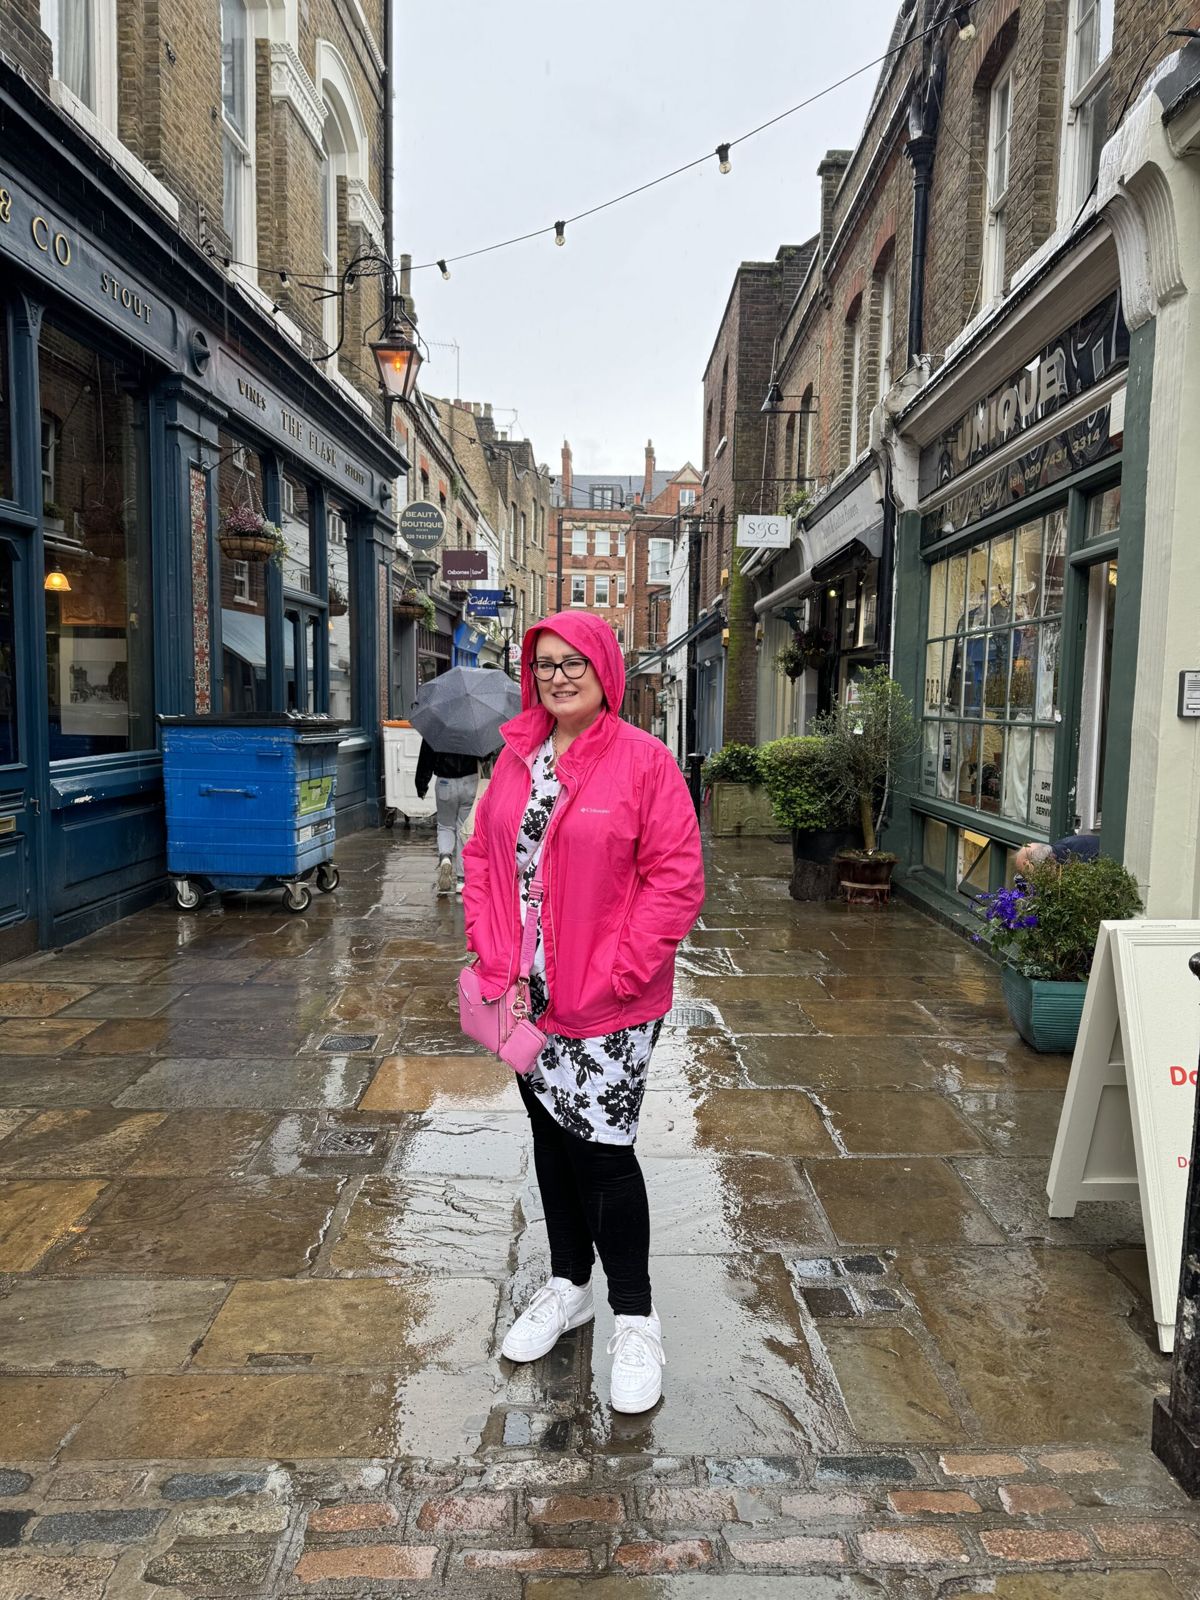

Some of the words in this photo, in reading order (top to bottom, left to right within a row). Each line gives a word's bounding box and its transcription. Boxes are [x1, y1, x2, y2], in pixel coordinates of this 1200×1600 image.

[32, 216, 71, 266] CO
[102, 272, 152, 324] STOUT
[237, 378, 267, 412] WINES
[281, 409, 303, 442] THE
[309, 430, 338, 469] FLASK
[957, 351, 1060, 461] UNIQUE
[1025, 464, 1042, 480] 020
[1044, 447, 1068, 471] 7431
[1072, 428, 1100, 455] 3314
[401, 520, 444, 529] BOUTIQUE
[405, 511, 439, 519] BEAUTY
[1041, 781, 1051, 791] DRY
